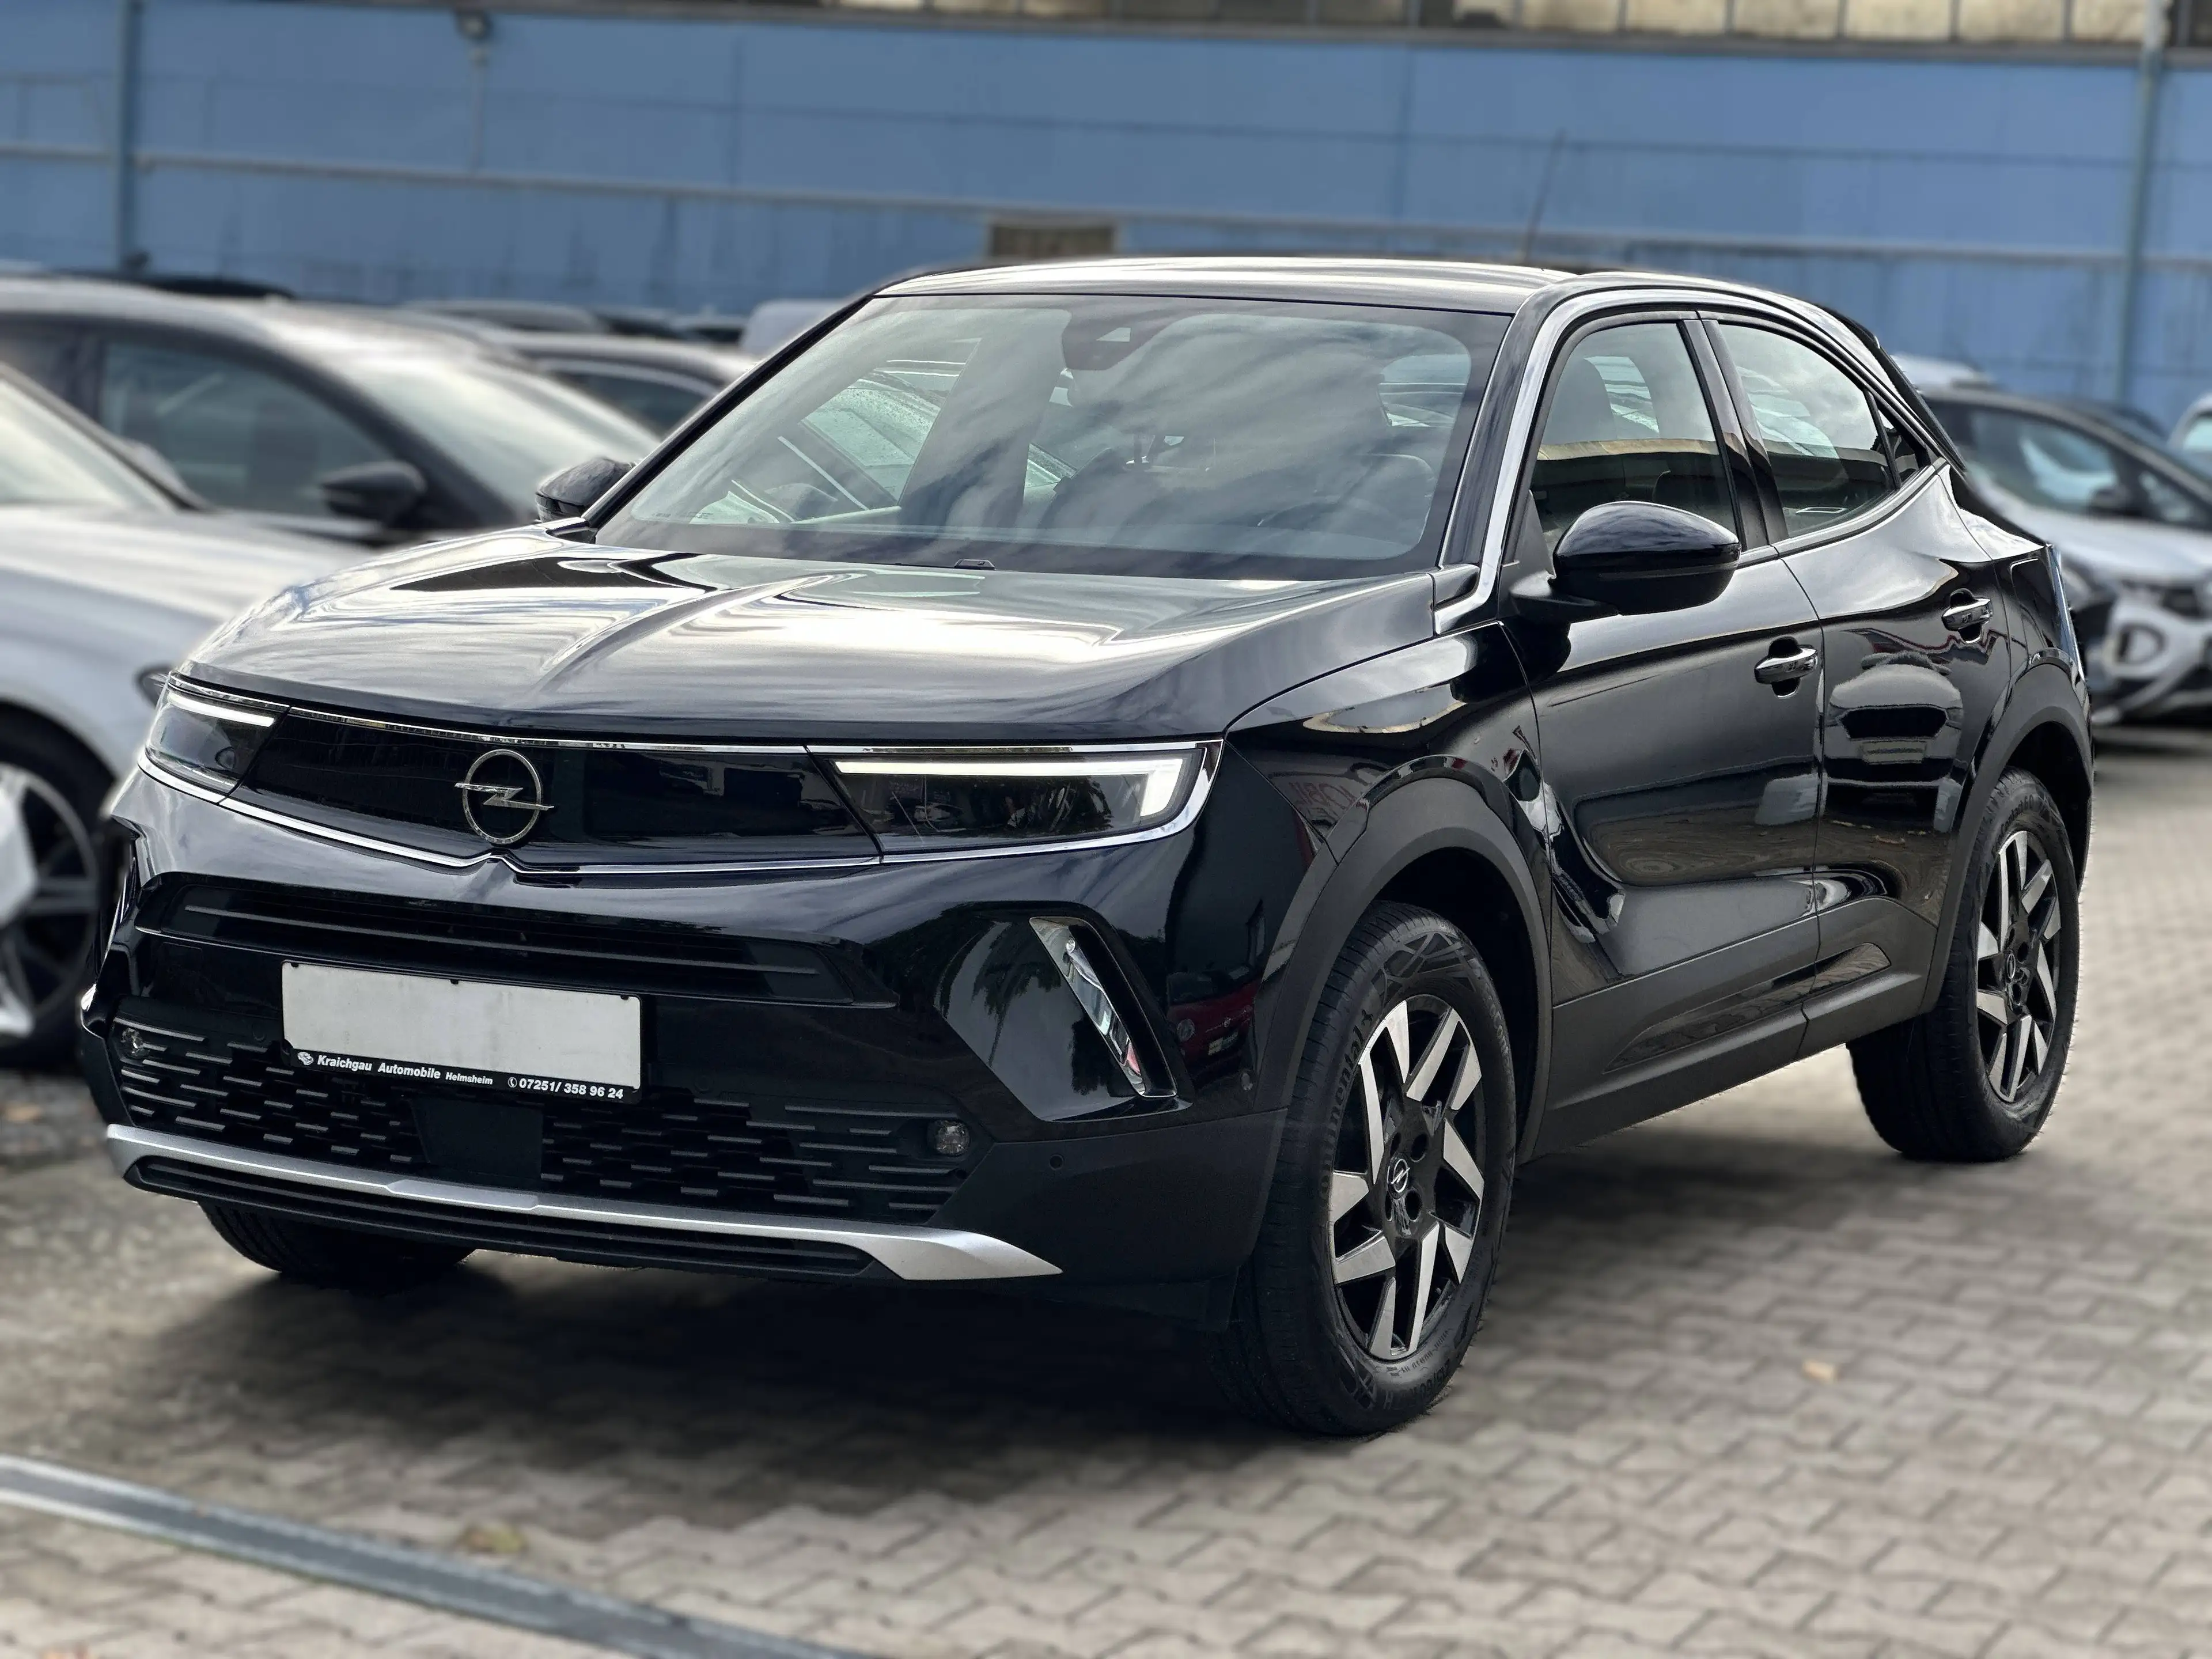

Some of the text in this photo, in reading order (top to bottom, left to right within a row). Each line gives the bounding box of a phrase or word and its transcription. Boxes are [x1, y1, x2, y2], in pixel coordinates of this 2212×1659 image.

[317, 1055, 624, 1100] Kraichgau Automobile Helmsheim 07251/ 358 96 24
